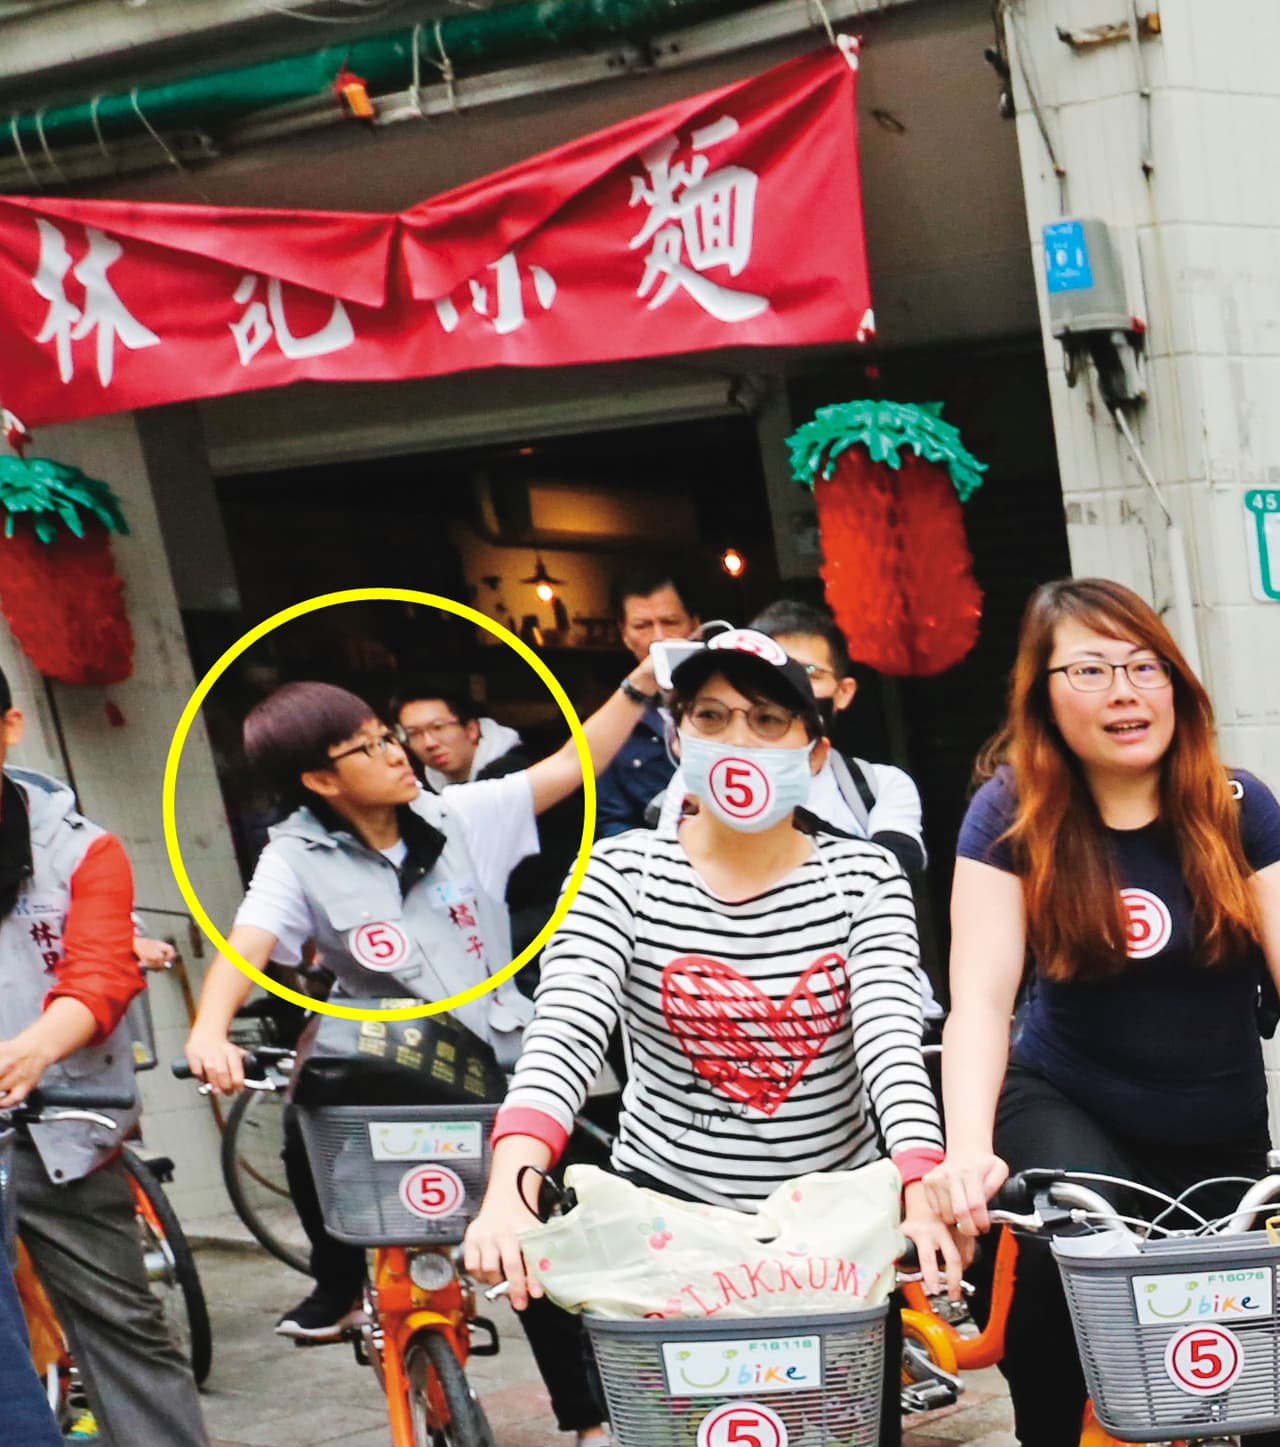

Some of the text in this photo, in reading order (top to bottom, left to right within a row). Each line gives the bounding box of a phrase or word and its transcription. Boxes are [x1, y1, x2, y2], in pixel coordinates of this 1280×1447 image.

[1252, 493, 1278, 511] 45
[725, 767, 754, 808] 5
[367, 929, 395, 959] 5
[421, 1177, 447, 1207] 5
[1191, 1339, 1222, 1379] 5
